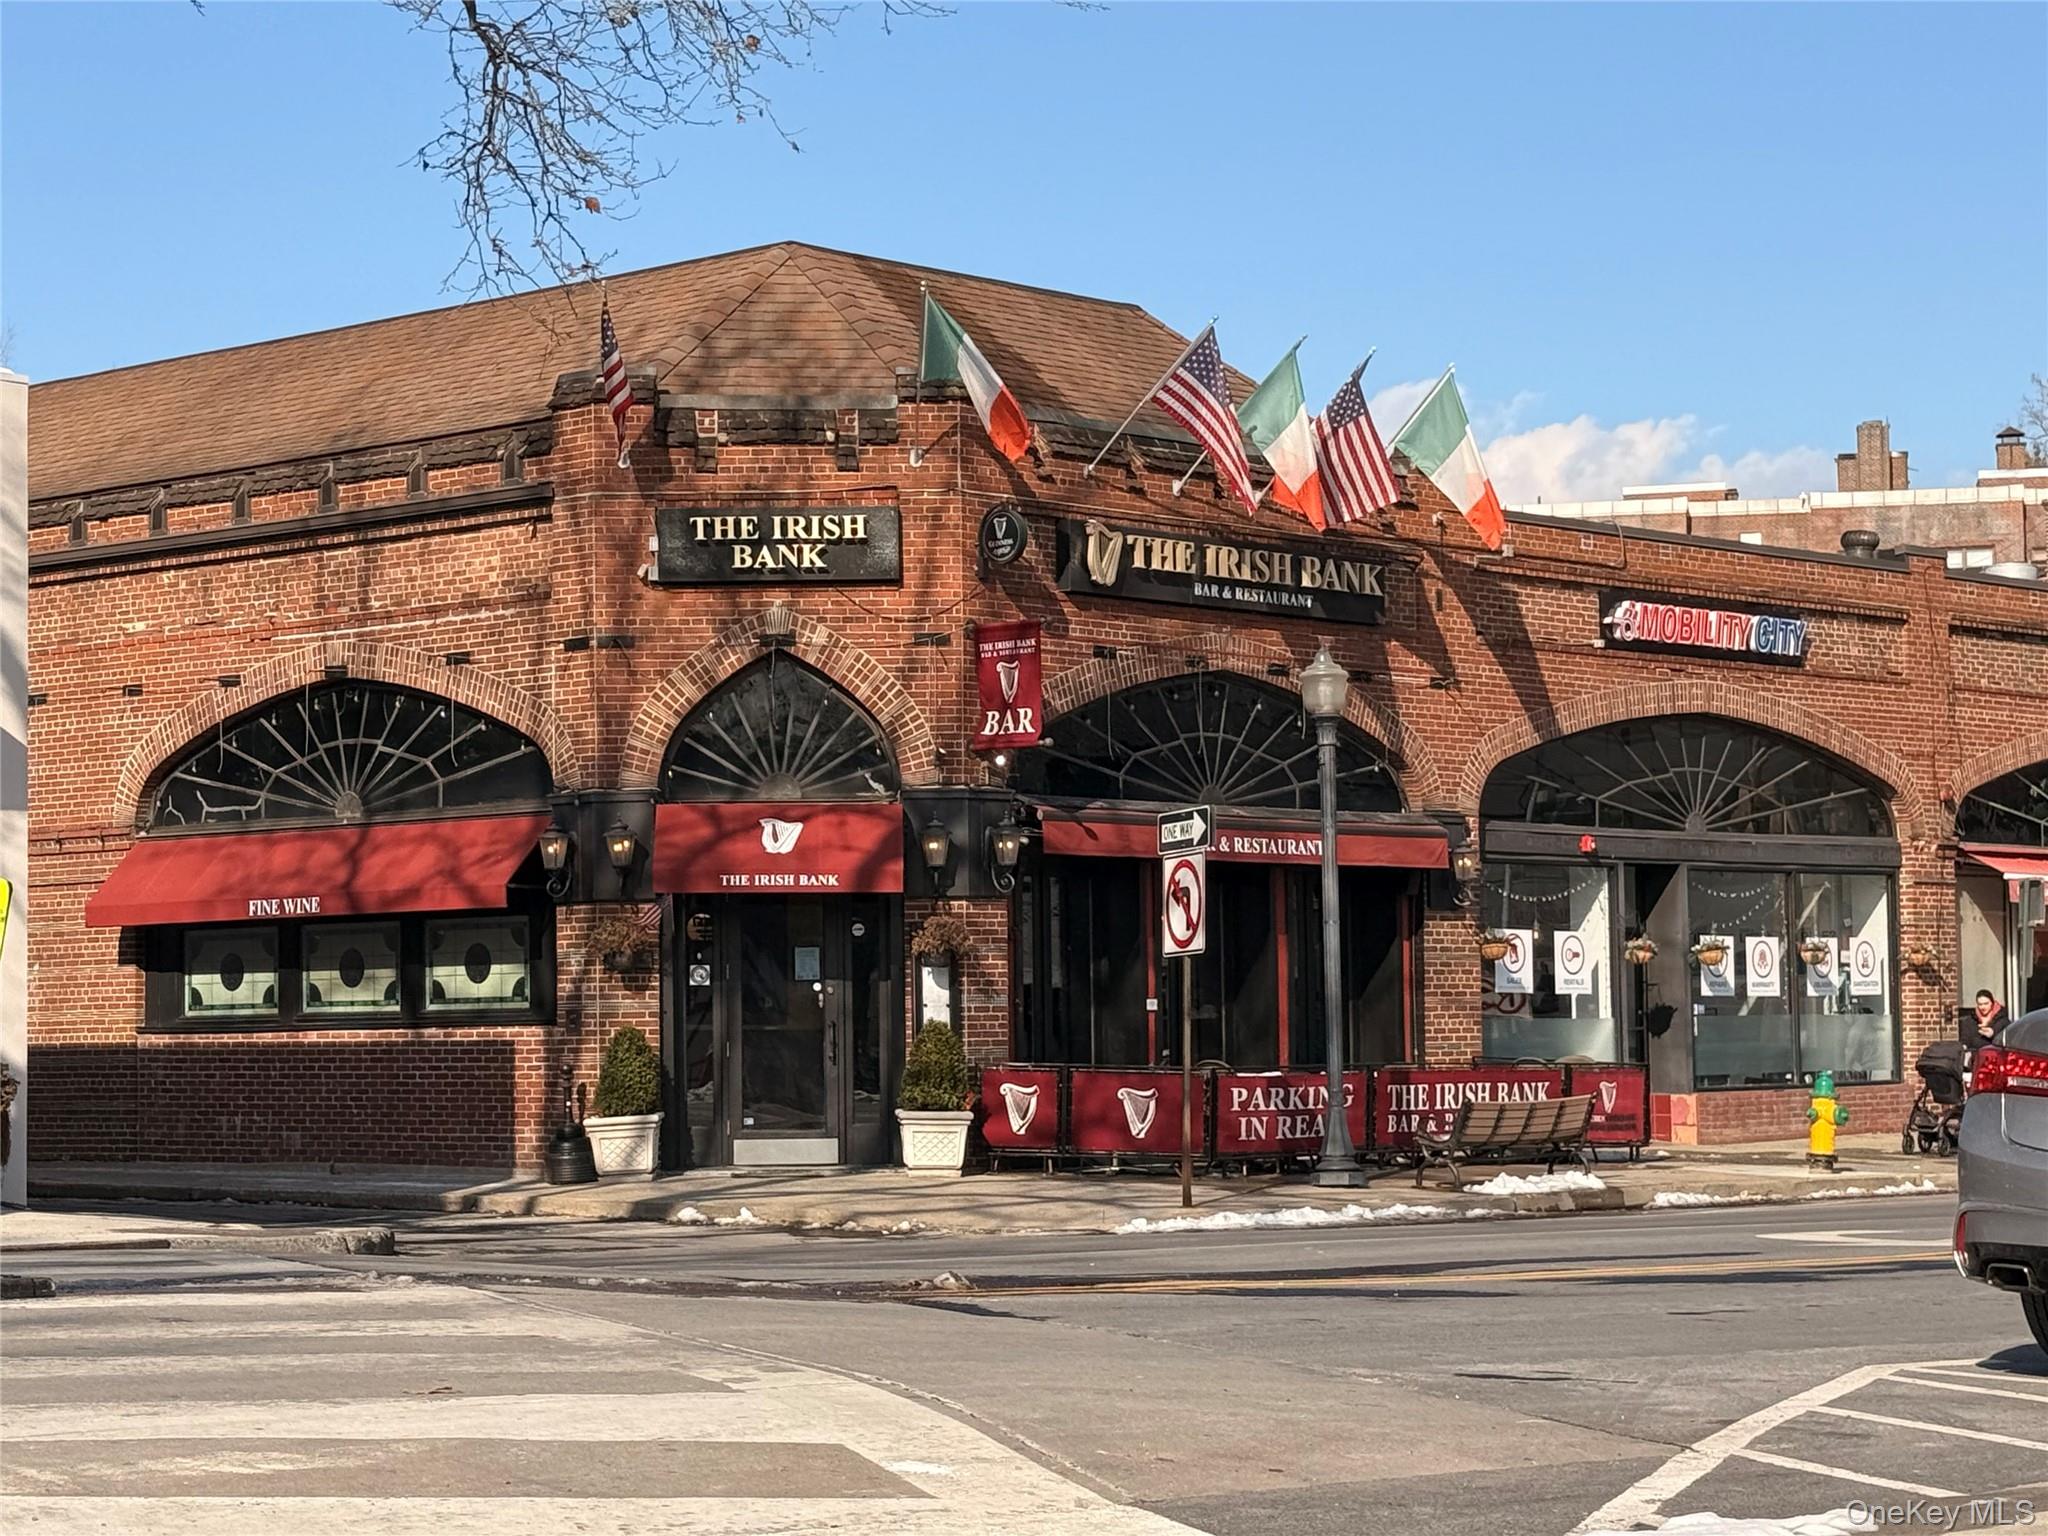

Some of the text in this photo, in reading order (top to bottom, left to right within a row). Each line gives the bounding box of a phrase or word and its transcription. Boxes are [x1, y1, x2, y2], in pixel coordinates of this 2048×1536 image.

[690, 514, 868, 541] THE IRISH
[731, 543, 827, 569] BANK
[1125, 534, 1384, 597] THE IRISH BANK
[1193, 582, 1314, 608] BAR & RESTAURANT
[1640, 602, 1807, 657] MOBILITY CITY
[979, 638, 1037, 652] THE IRISH BANK
[980, 707, 1036, 736] BAR
[1163, 822, 1194, 841] ONE WAY
[1219, 836, 1323, 856] & RESTAURANT
[720, 874, 839, 886] THE IRISH BANK
[248, 896, 321, 917] FINE WINE
[1387, 1082, 1551, 1111] THE IRISH BANK
[1238, 1113, 1326, 1141] IN REA
[1387, 1114, 1420, 1133] BAR
[1426, 1113, 1438, 1133] &
